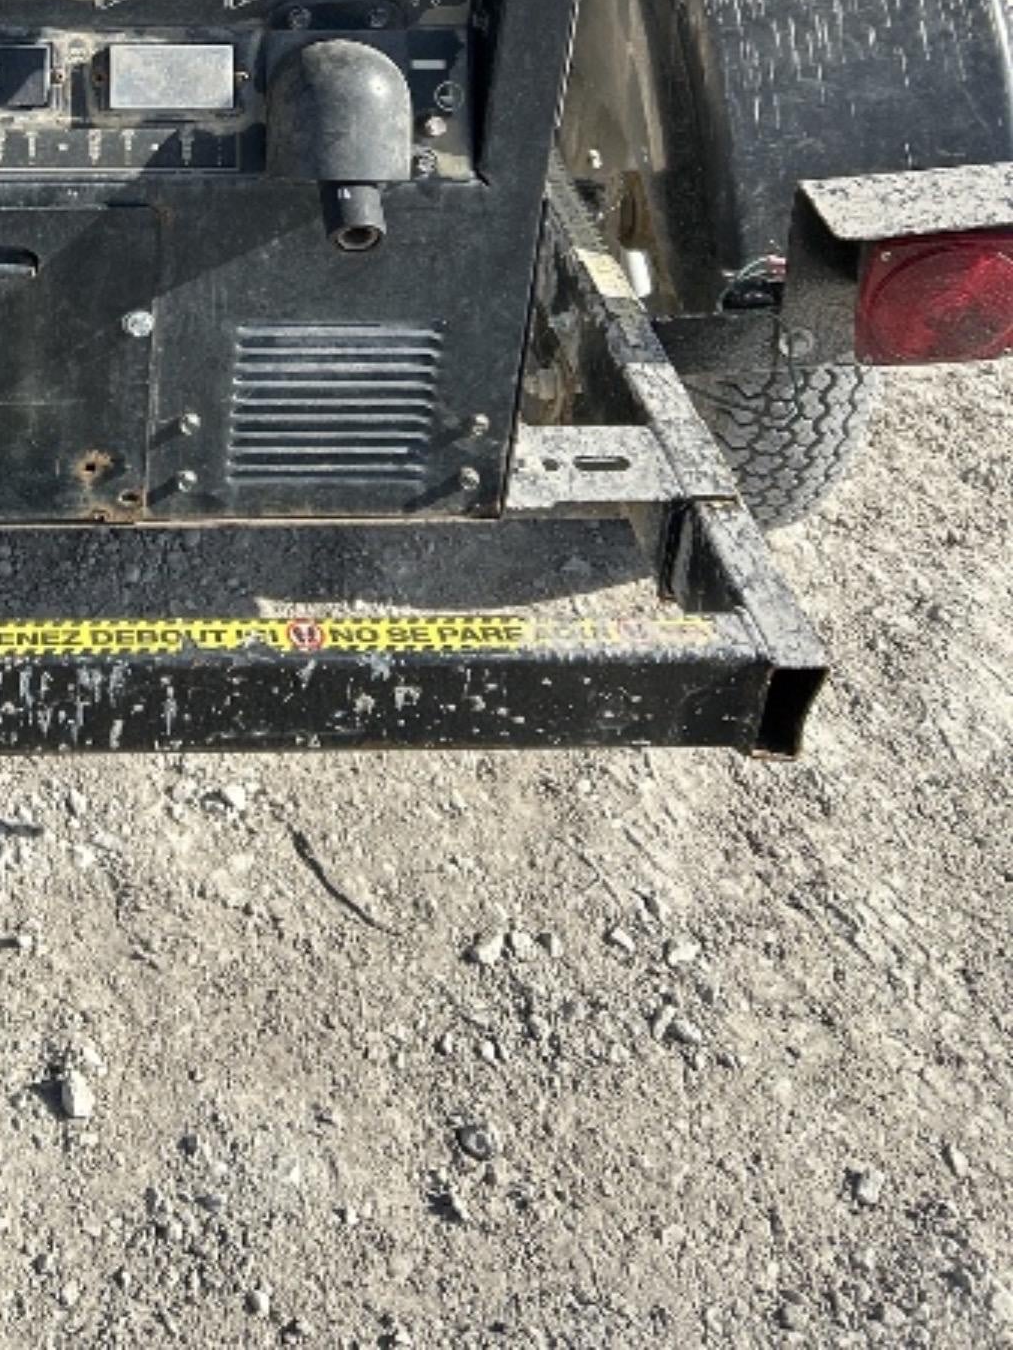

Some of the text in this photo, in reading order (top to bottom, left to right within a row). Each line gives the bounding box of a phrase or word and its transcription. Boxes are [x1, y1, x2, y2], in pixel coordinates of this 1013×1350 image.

[91, 629, 227, 646] DEBOUT
[329, 625, 383, 644] NO
[438, 625, 523, 644] PARE
